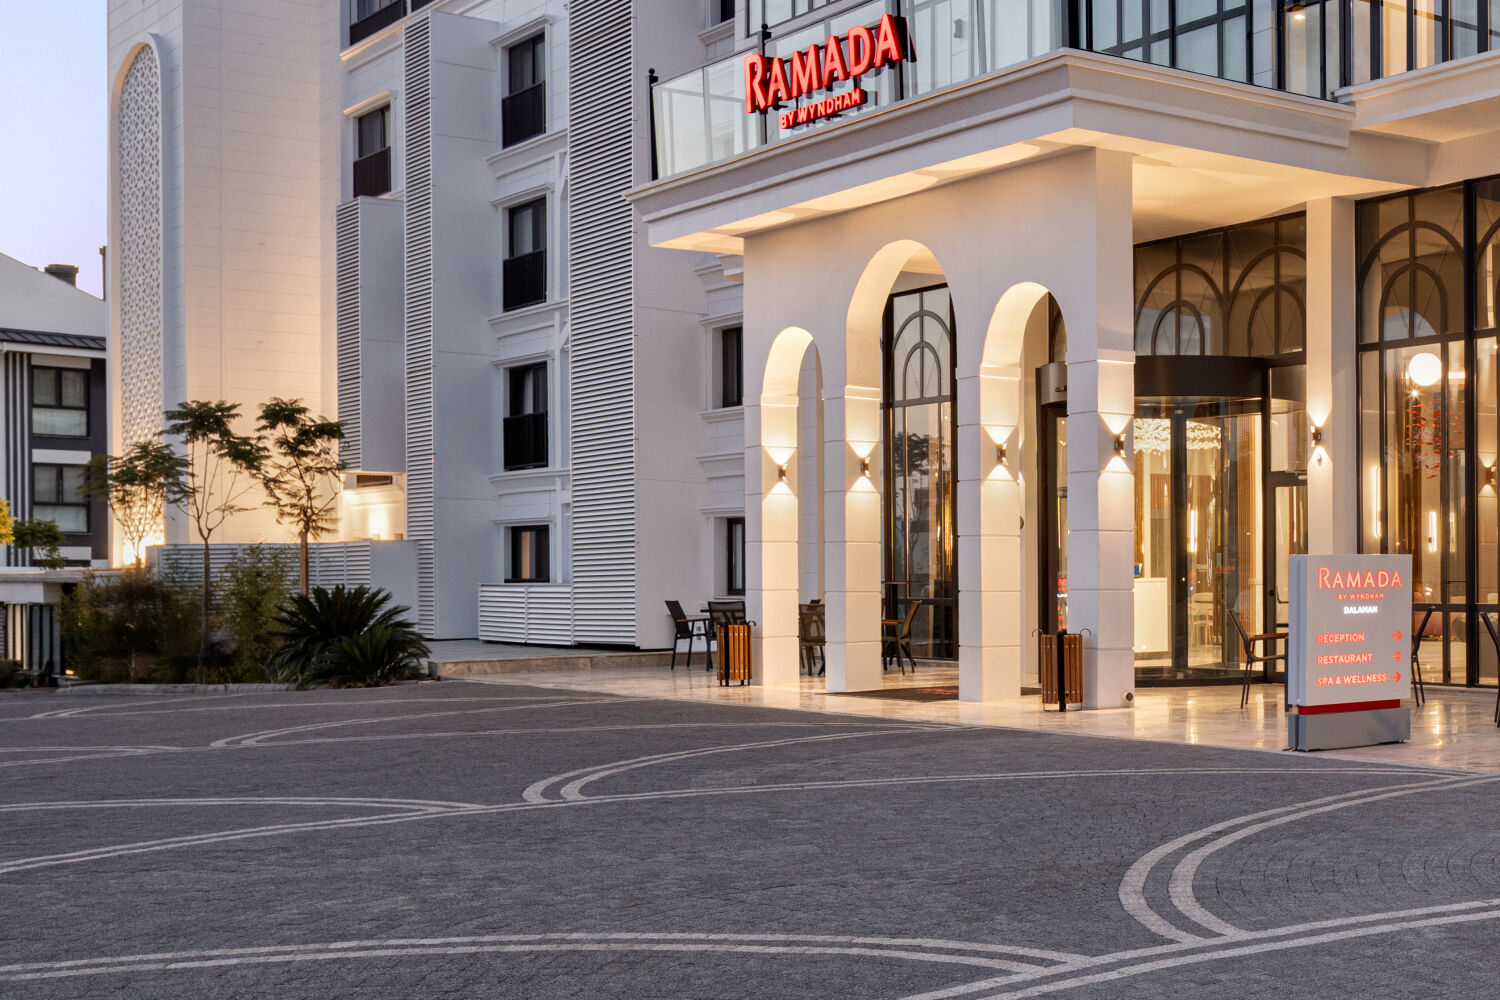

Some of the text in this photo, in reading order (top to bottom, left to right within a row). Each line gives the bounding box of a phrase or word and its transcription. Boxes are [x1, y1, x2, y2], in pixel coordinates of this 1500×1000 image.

[744, 12, 903, 114] RAMADA
[779, 87, 866, 129] BY WYNDHAM
[1318, 566, 1402, 589] RAMADA
[1337, 592, 1385, 601] BY WYNDHAM
[1343, 605, 1378, 614] DALAMAN
[1317, 632, 1365, 643] RECEPTION
[1317, 653, 1373, 665] RESTAURANT
[1317, 673, 1387, 686] SPA & WELLNESS
